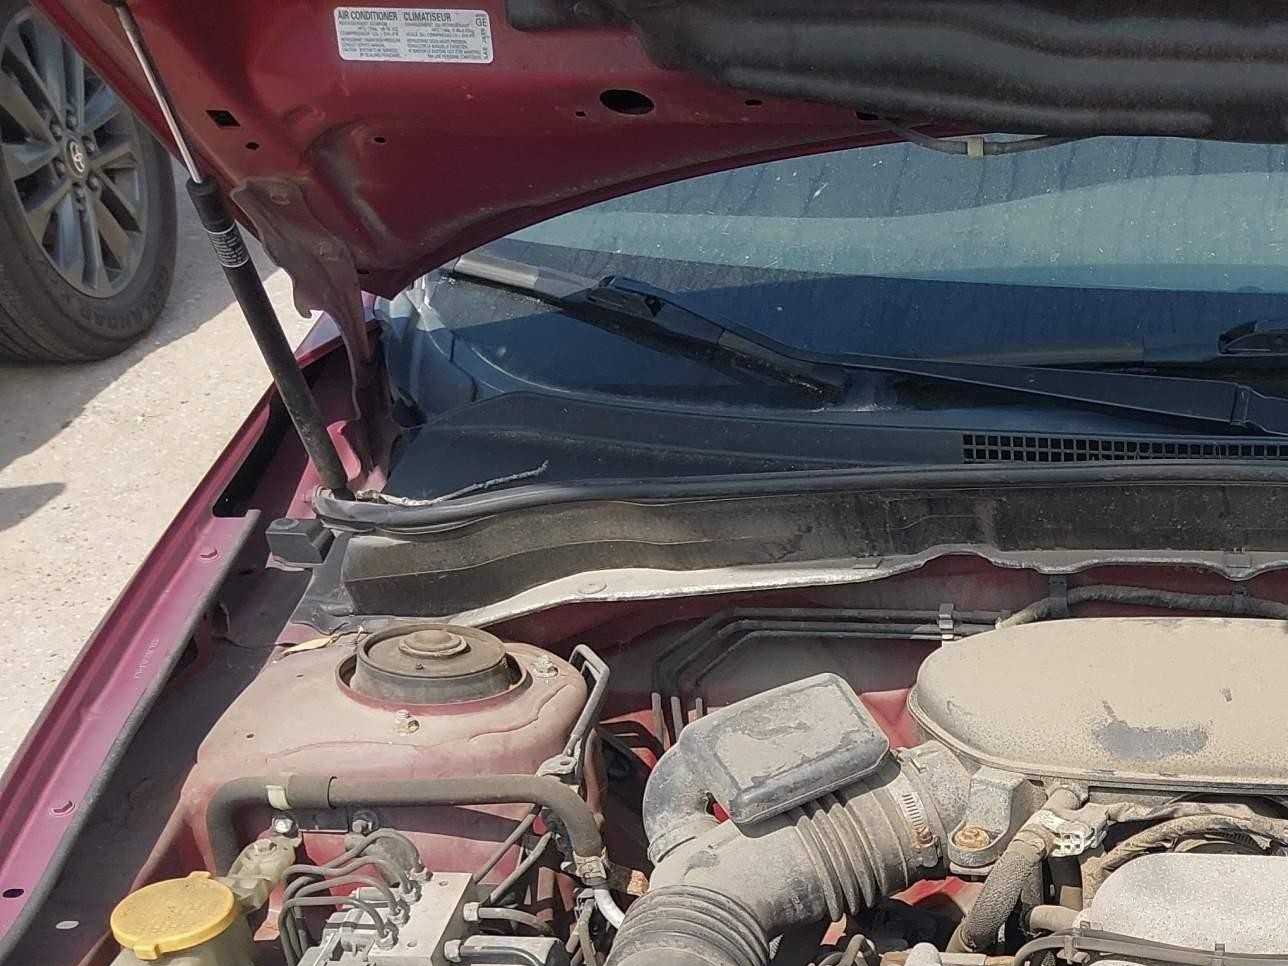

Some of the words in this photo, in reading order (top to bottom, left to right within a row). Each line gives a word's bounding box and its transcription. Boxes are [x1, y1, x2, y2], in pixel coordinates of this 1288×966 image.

[338, 11, 349, 20] AIR
[351, 11, 398, 20] CONDITIONER
[403, 12, 452, 22] CLIMATISEUR
